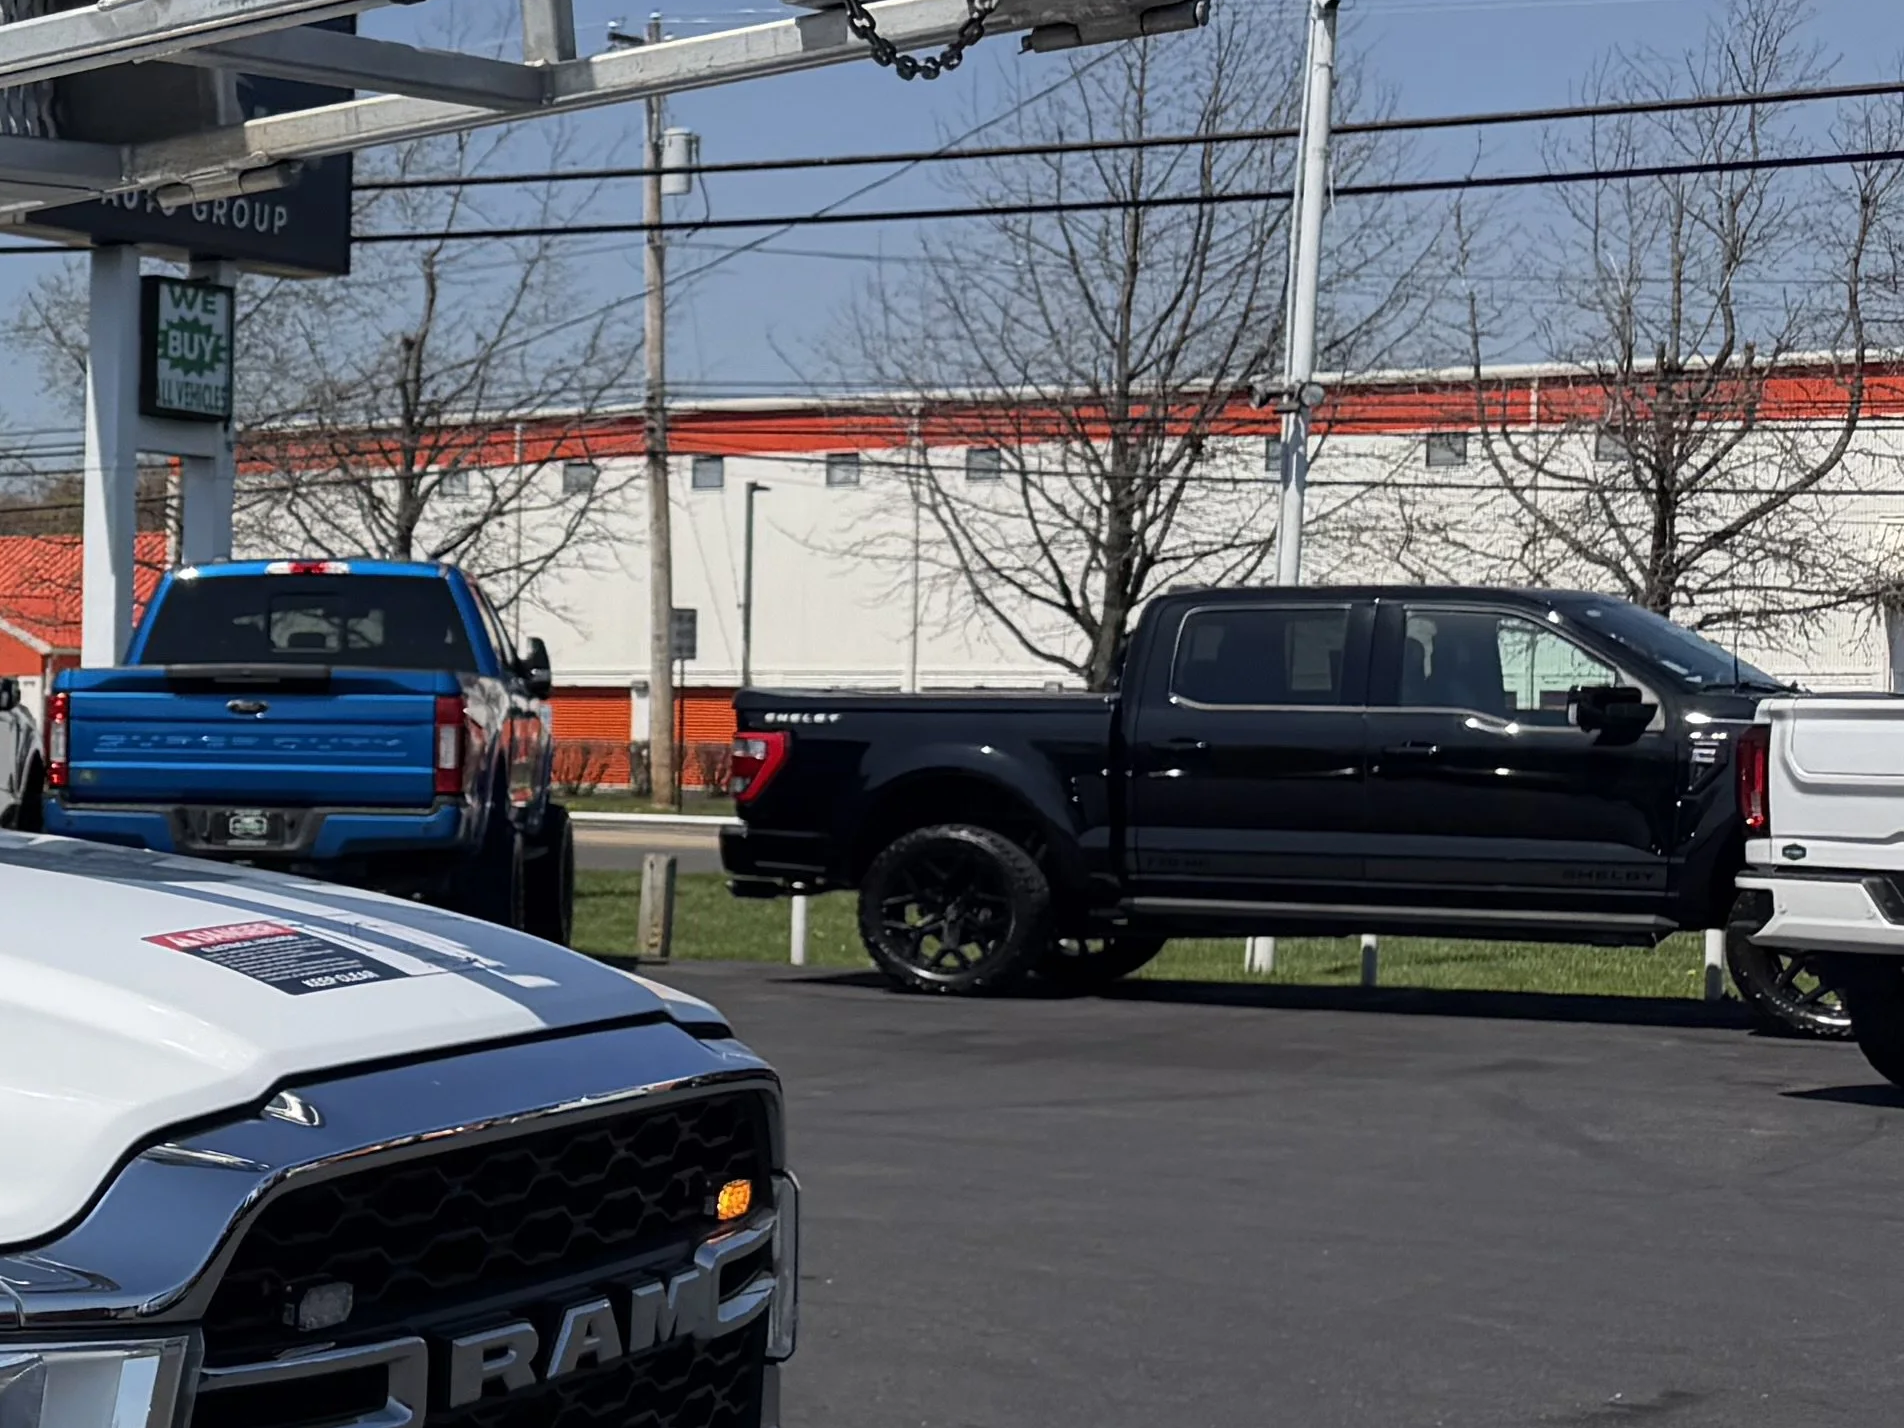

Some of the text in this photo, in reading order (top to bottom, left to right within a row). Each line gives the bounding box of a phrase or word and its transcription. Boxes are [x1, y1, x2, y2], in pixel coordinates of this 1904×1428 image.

[192, 197, 288, 235] GROUP
[168, 283, 218, 315] WE
[167, 330, 217, 362] BUY
[301, 970, 380, 988] KEEP CLEAR
[449, 1270, 699, 1408] RAM
